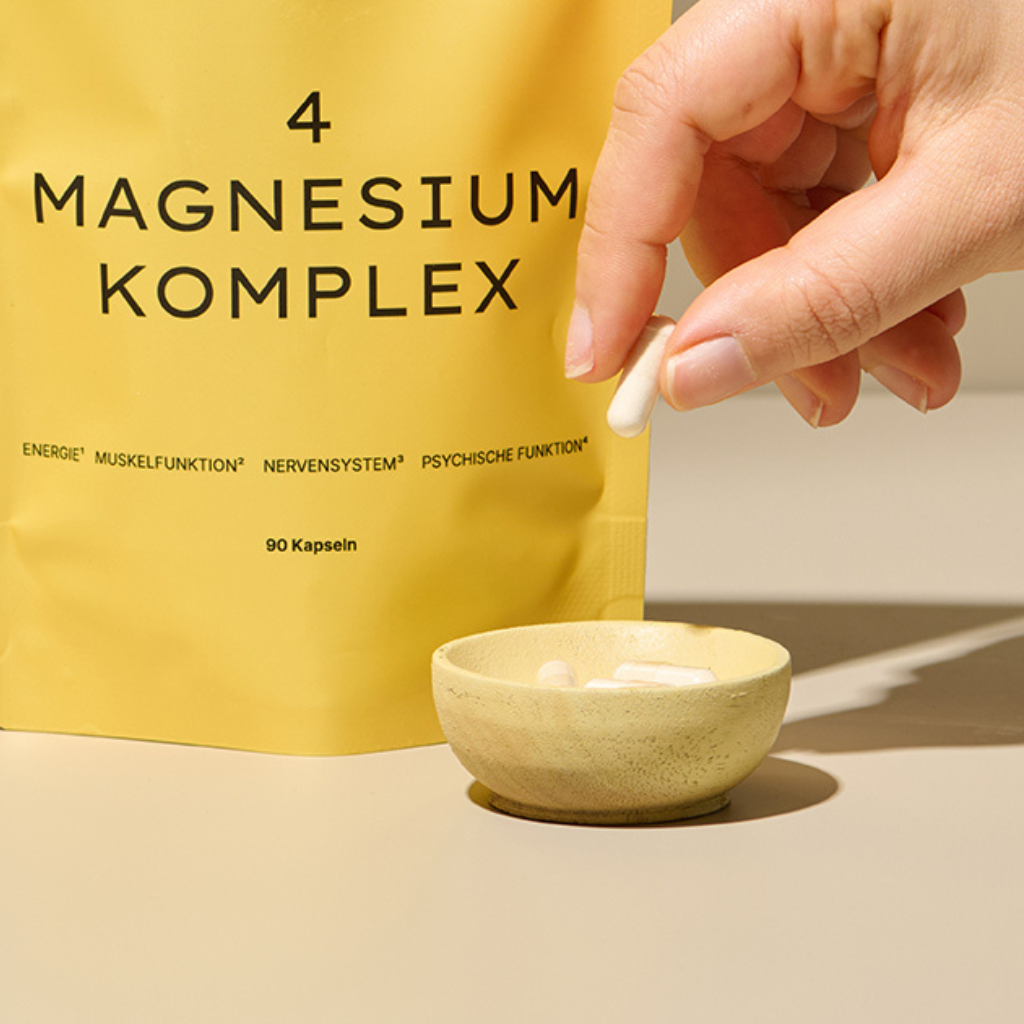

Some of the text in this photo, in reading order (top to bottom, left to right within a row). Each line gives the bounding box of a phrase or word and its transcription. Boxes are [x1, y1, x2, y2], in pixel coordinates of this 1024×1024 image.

[286, 91, 331, 143] 4
[33, 168, 578, 232] MAGNESIUM
[99, 259, 521, 319] KOMPLEX
[422, 447, 514, 469] PSYCHISCHE
[266, 538, 357, 555] 90 Kapseln
